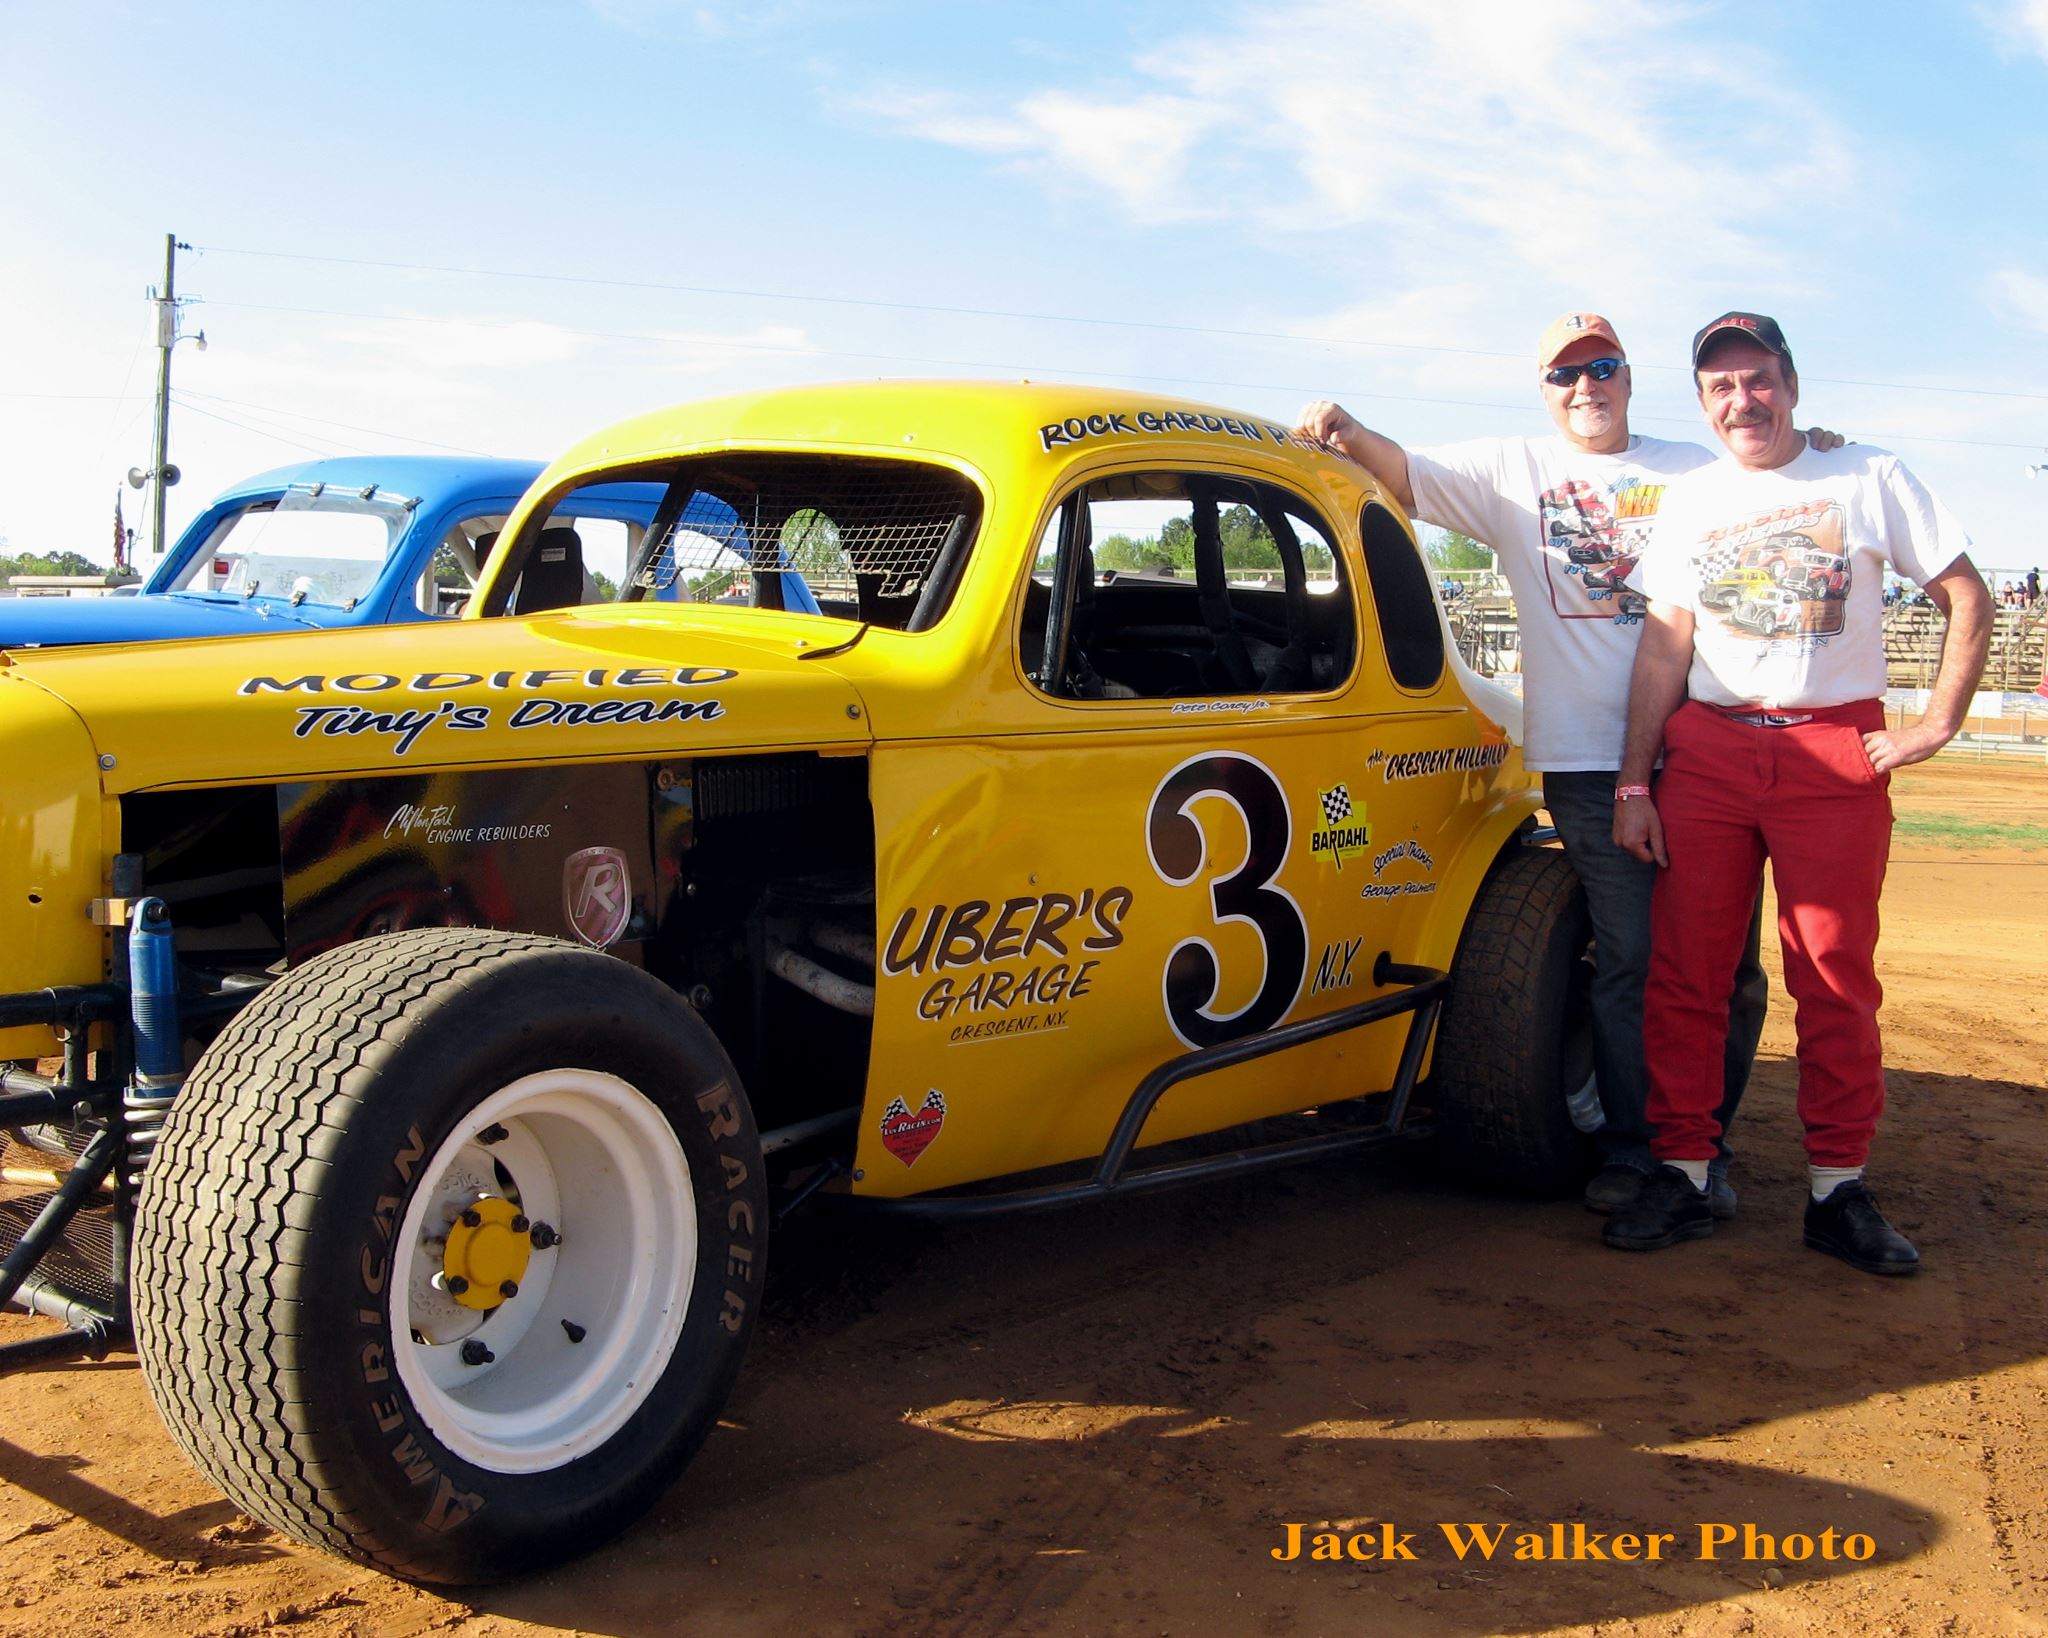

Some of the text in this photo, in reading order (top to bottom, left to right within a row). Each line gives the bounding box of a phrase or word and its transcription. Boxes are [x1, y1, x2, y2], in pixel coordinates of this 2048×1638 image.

[1565, 315, 1584, 329] 4
[1039, 411, 1262, 453] ROCK GARDEN
[236, 667, 740, 696] MODIFIED
[294, 698, 727, 756] Tiny's Dream
[1171, 703, 1208, 715] Pete
[427, 824, 552, 844] ENGINE REBUILDERS
[1312, 827, 1369, 851] BARDAHL
[575, 862, 622, 918] R
[1145, 750, 1310, 1051] 3
[1361, 883, 1401, 904] George
[881, 886, 1134, 977] UBER'S
[916, 960, 1101, 1022] GARAGE
[1043, 1010, 1069, 1027] N.Y.
[696, 1080, 755, 1336] RACER
[359, 1124, 488, 1534] AMERICAN
